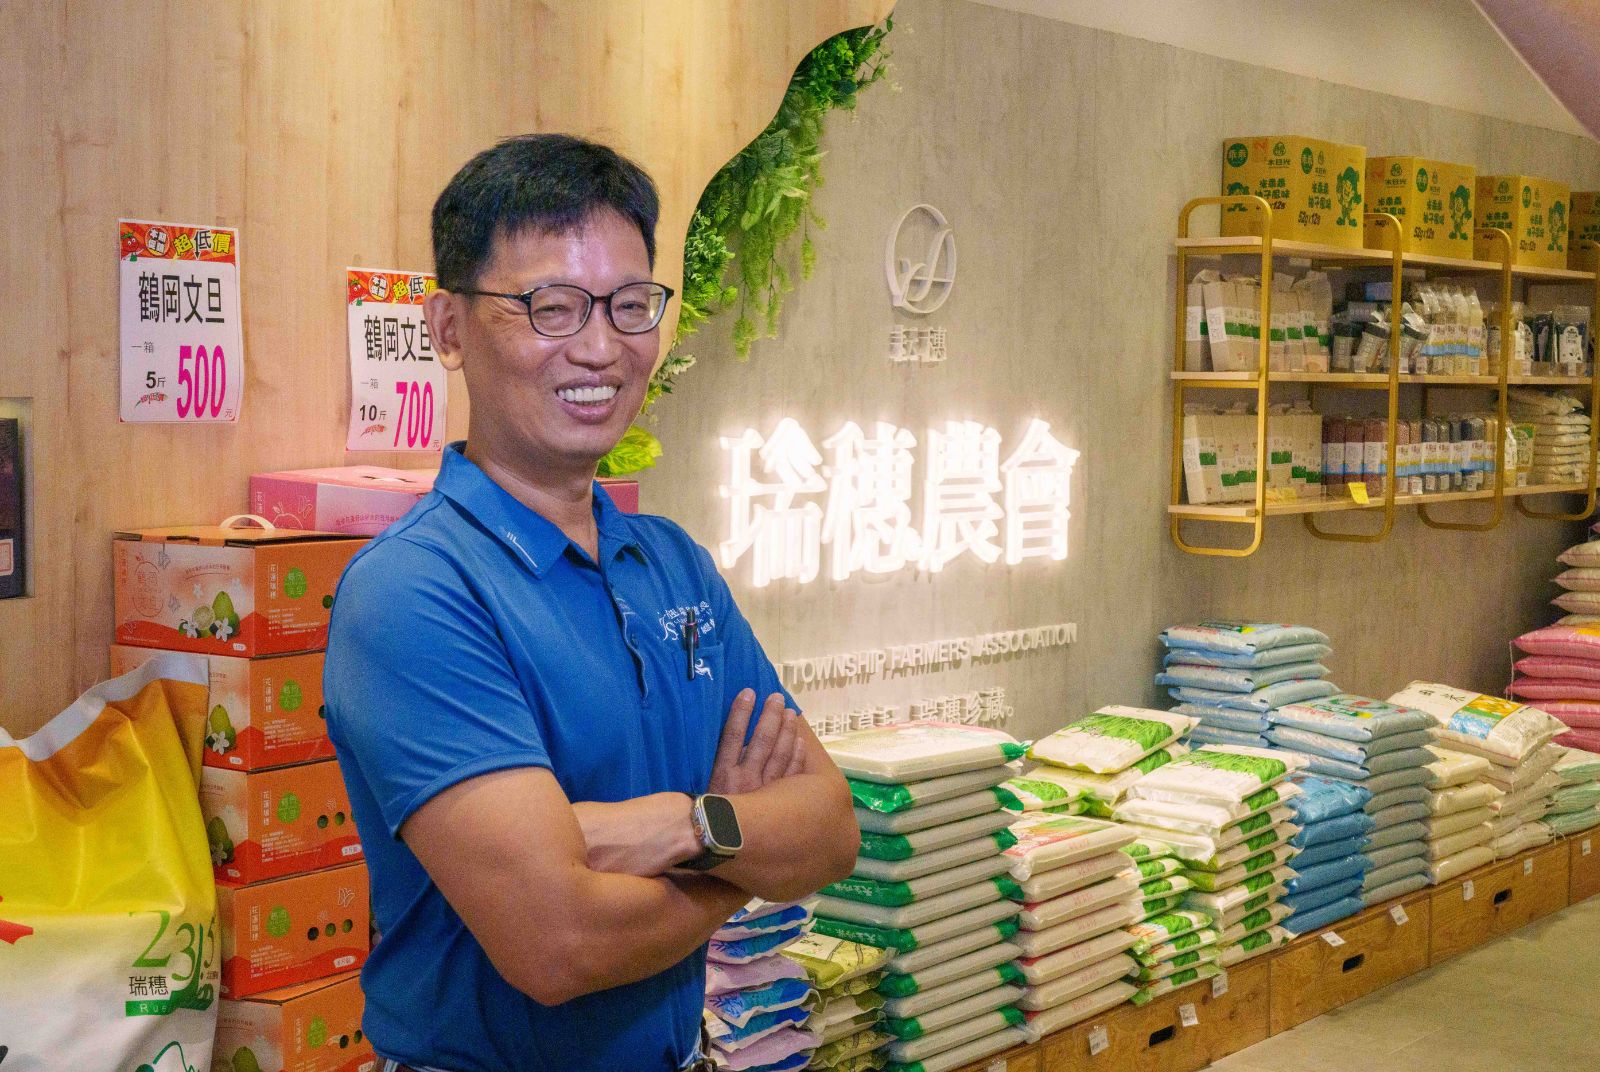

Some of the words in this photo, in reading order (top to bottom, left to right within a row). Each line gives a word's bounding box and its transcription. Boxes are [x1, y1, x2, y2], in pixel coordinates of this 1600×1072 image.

[173, 229, 231, 257] 超低價
[138, 271, 225, 324] 鶴岡文旦
[131, 341, 154, 354] 一箱
[363, 314, 434, 362] 鶴岡文旦
[177, 345, 226, 418] 500
[394, 381, 433, 448] 700
[718, 415, 1082, 588] 瑞穗農會
[786, 648, 886, 685] TOWNSHIP
[883, 634, 970, 669] FARMERS
[972, 622, 1078, 657] ASSOCIATION
[128, 975, 169, 997] 瑞穗
